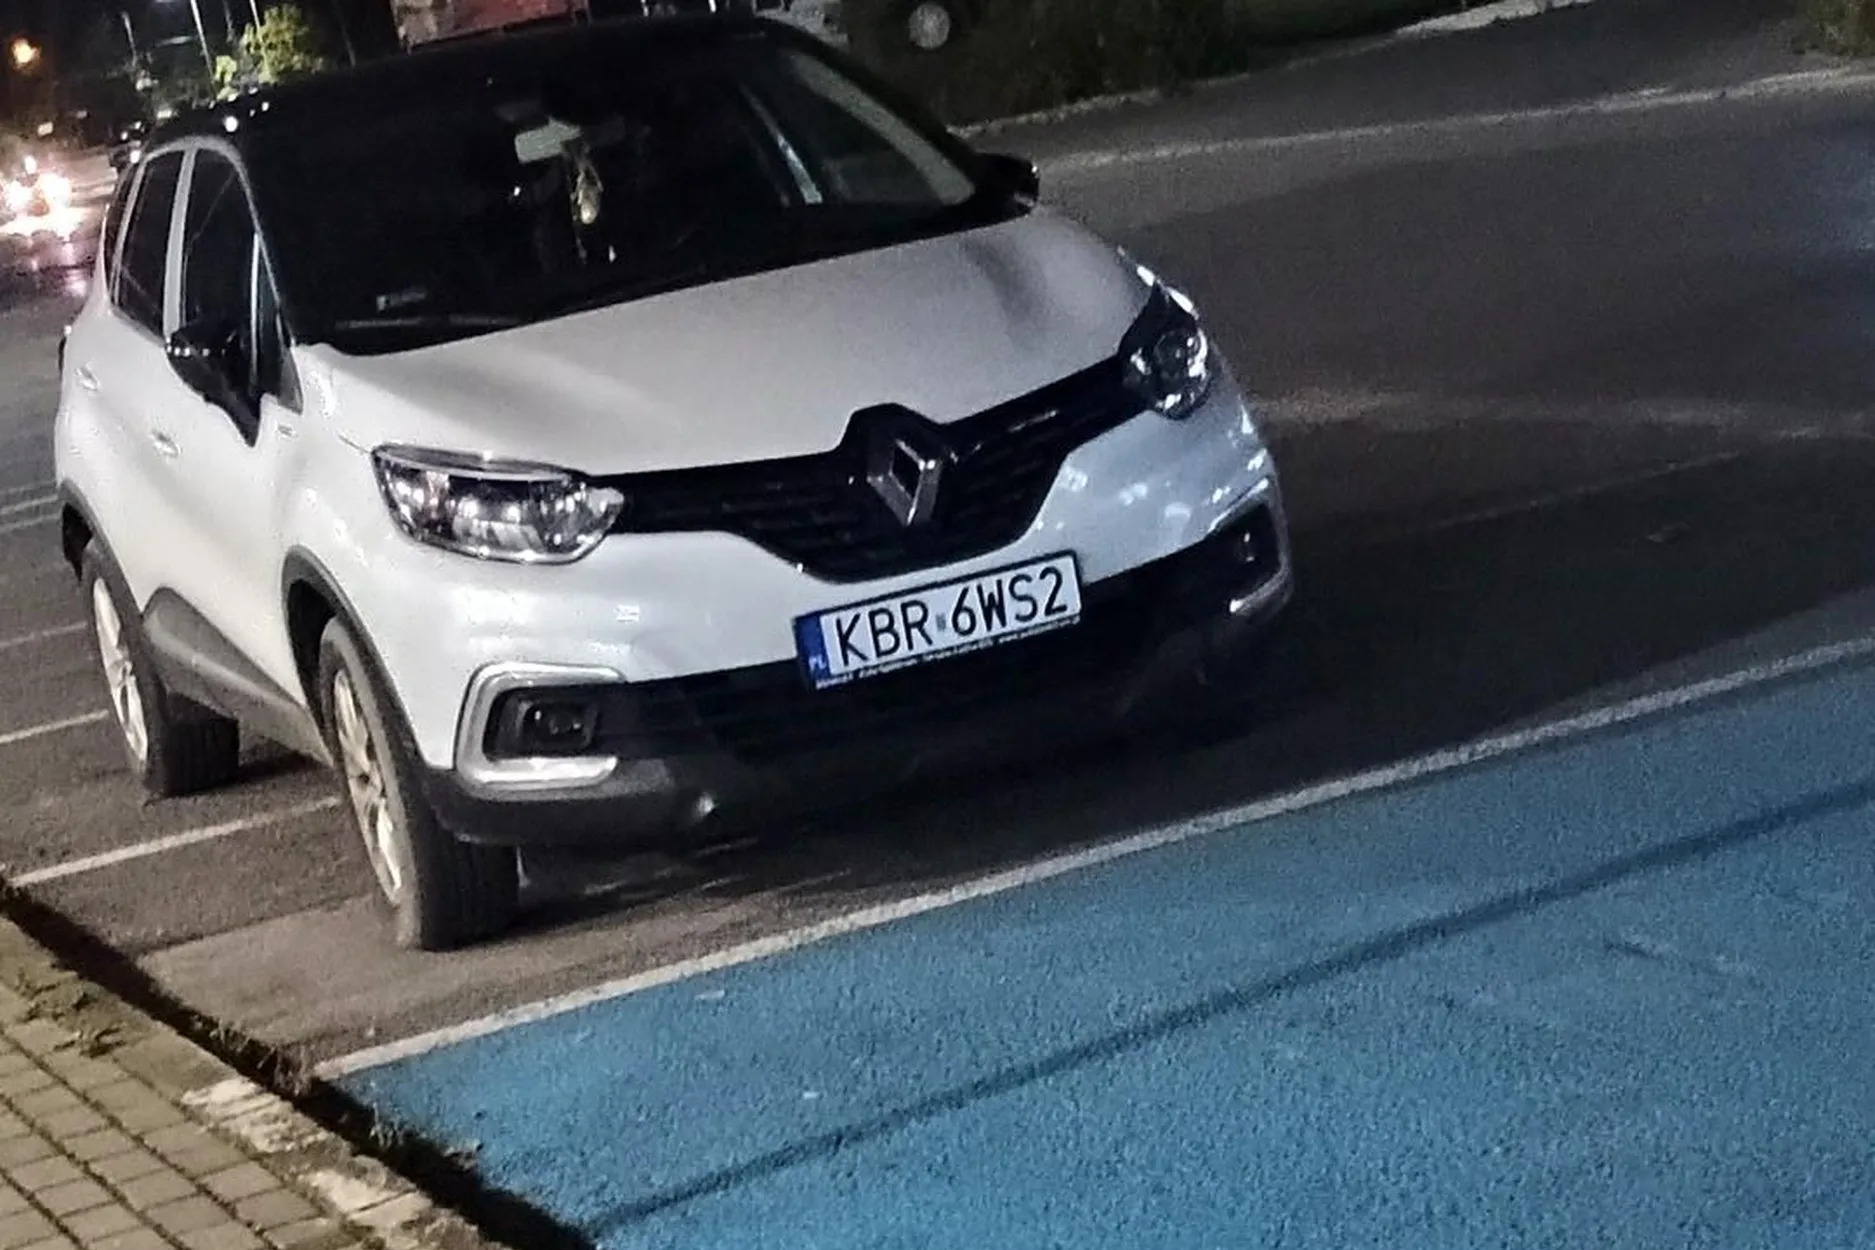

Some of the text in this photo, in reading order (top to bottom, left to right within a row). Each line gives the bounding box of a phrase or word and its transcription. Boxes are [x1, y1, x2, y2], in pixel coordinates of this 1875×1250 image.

[836, 600, 932, 666] KBR
[952, 567, 1067, 636] 6WS2
[809, 654, 827, 671] PL
